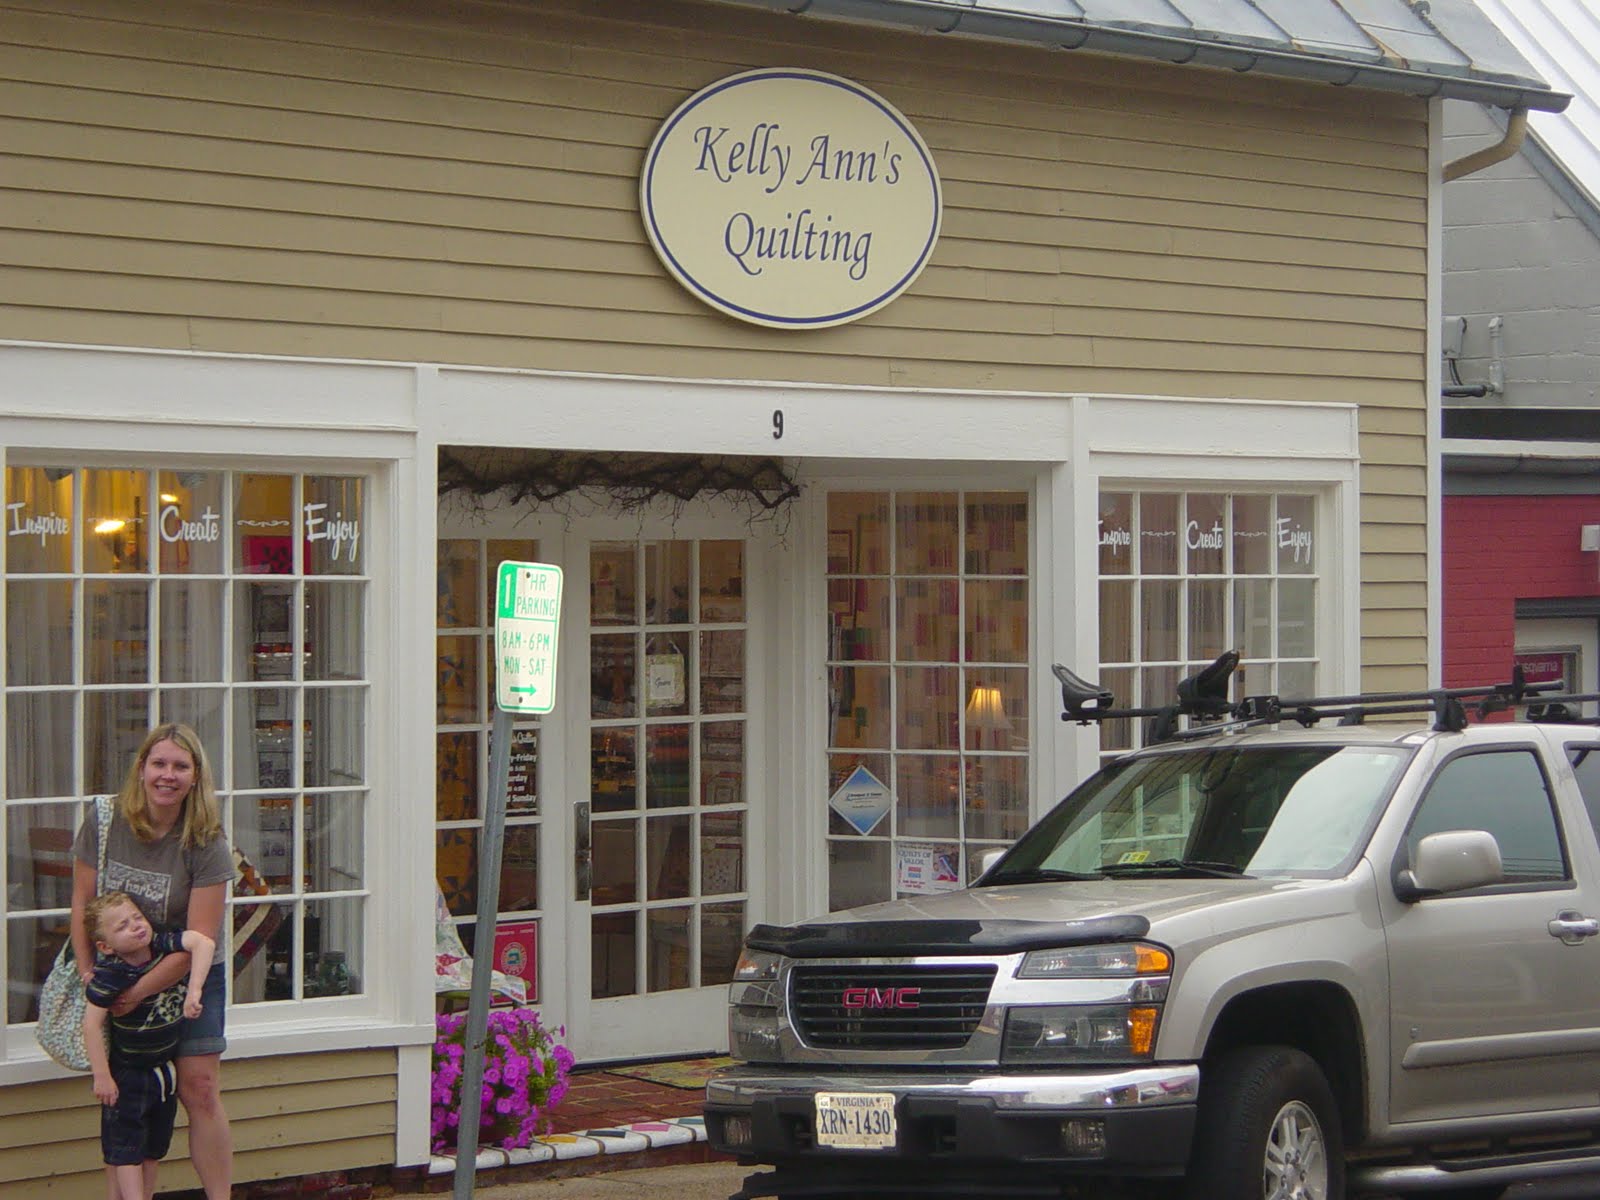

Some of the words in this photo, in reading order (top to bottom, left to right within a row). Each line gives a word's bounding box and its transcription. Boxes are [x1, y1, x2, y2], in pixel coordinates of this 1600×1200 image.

[693, 123, 791, 193] Kelly
[796, 134, 902, 185] Ann's
[724, 209, 873, 280] Quilting
[773, 410, 783, 440] 9
[6, 502, 69, 547] Inspire
[160, 505, 220, 542] Create
[304, 503, 360, 562] Enjoy
[1186, 520, 1224, 550] Create
[1276, 517, 1312, 564] Enjoy
[504, 573, 512, 609] 1
[530, 573, 547, 591] HR
[516, 596, 556, 616] PARKING
[125, 879, 164, 902] harbor
[842, 988, 921, 1008] GMC
[836, 1096, 875, 1107] VIRGINIA
